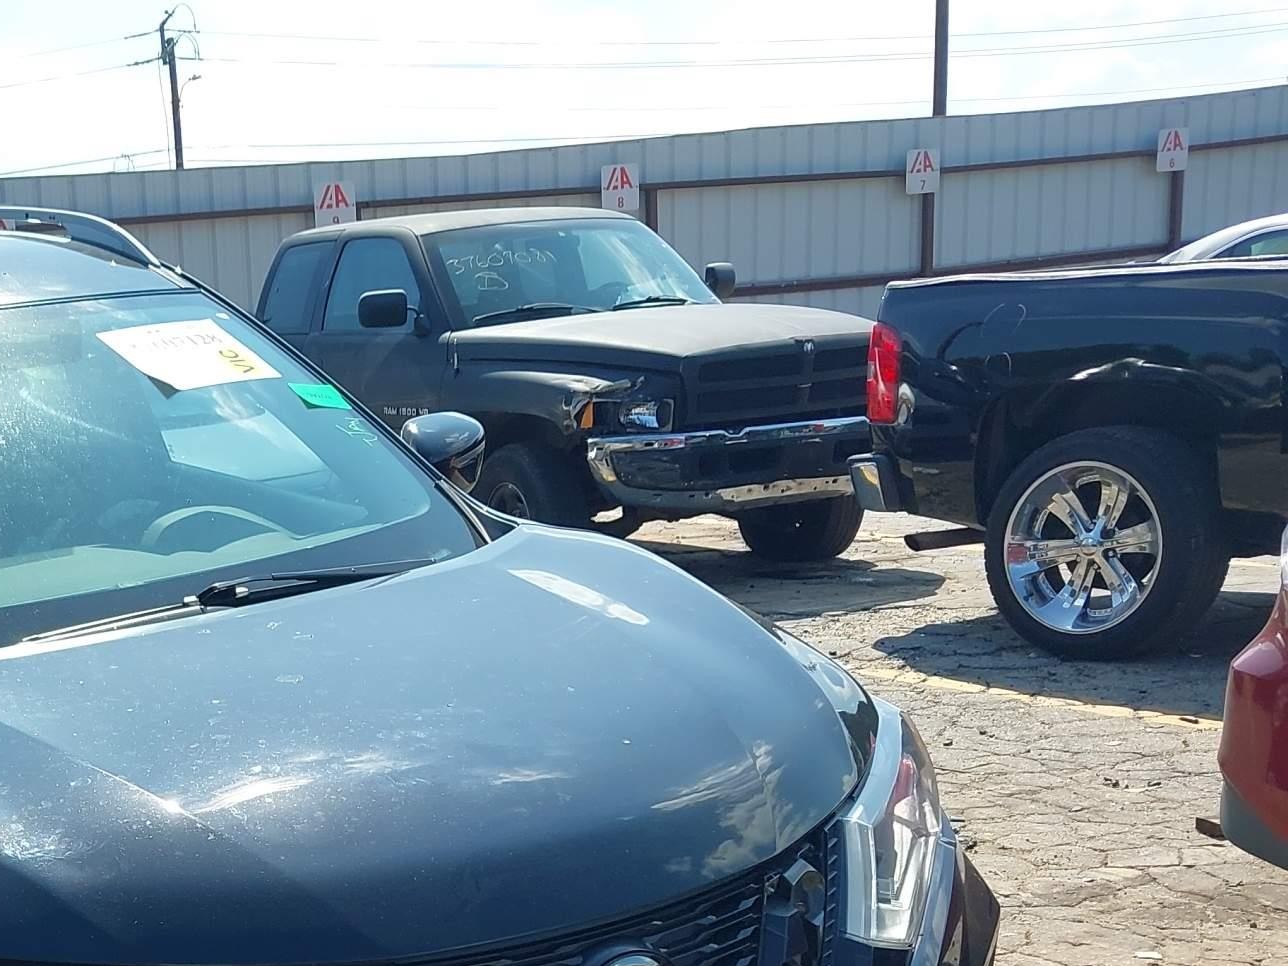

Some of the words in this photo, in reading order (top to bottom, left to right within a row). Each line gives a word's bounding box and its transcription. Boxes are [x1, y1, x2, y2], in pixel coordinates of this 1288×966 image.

[920, 179, 926, 190] 7
[617, 197, 624, 208] 8
[383, 406, 397, 416] RAM
